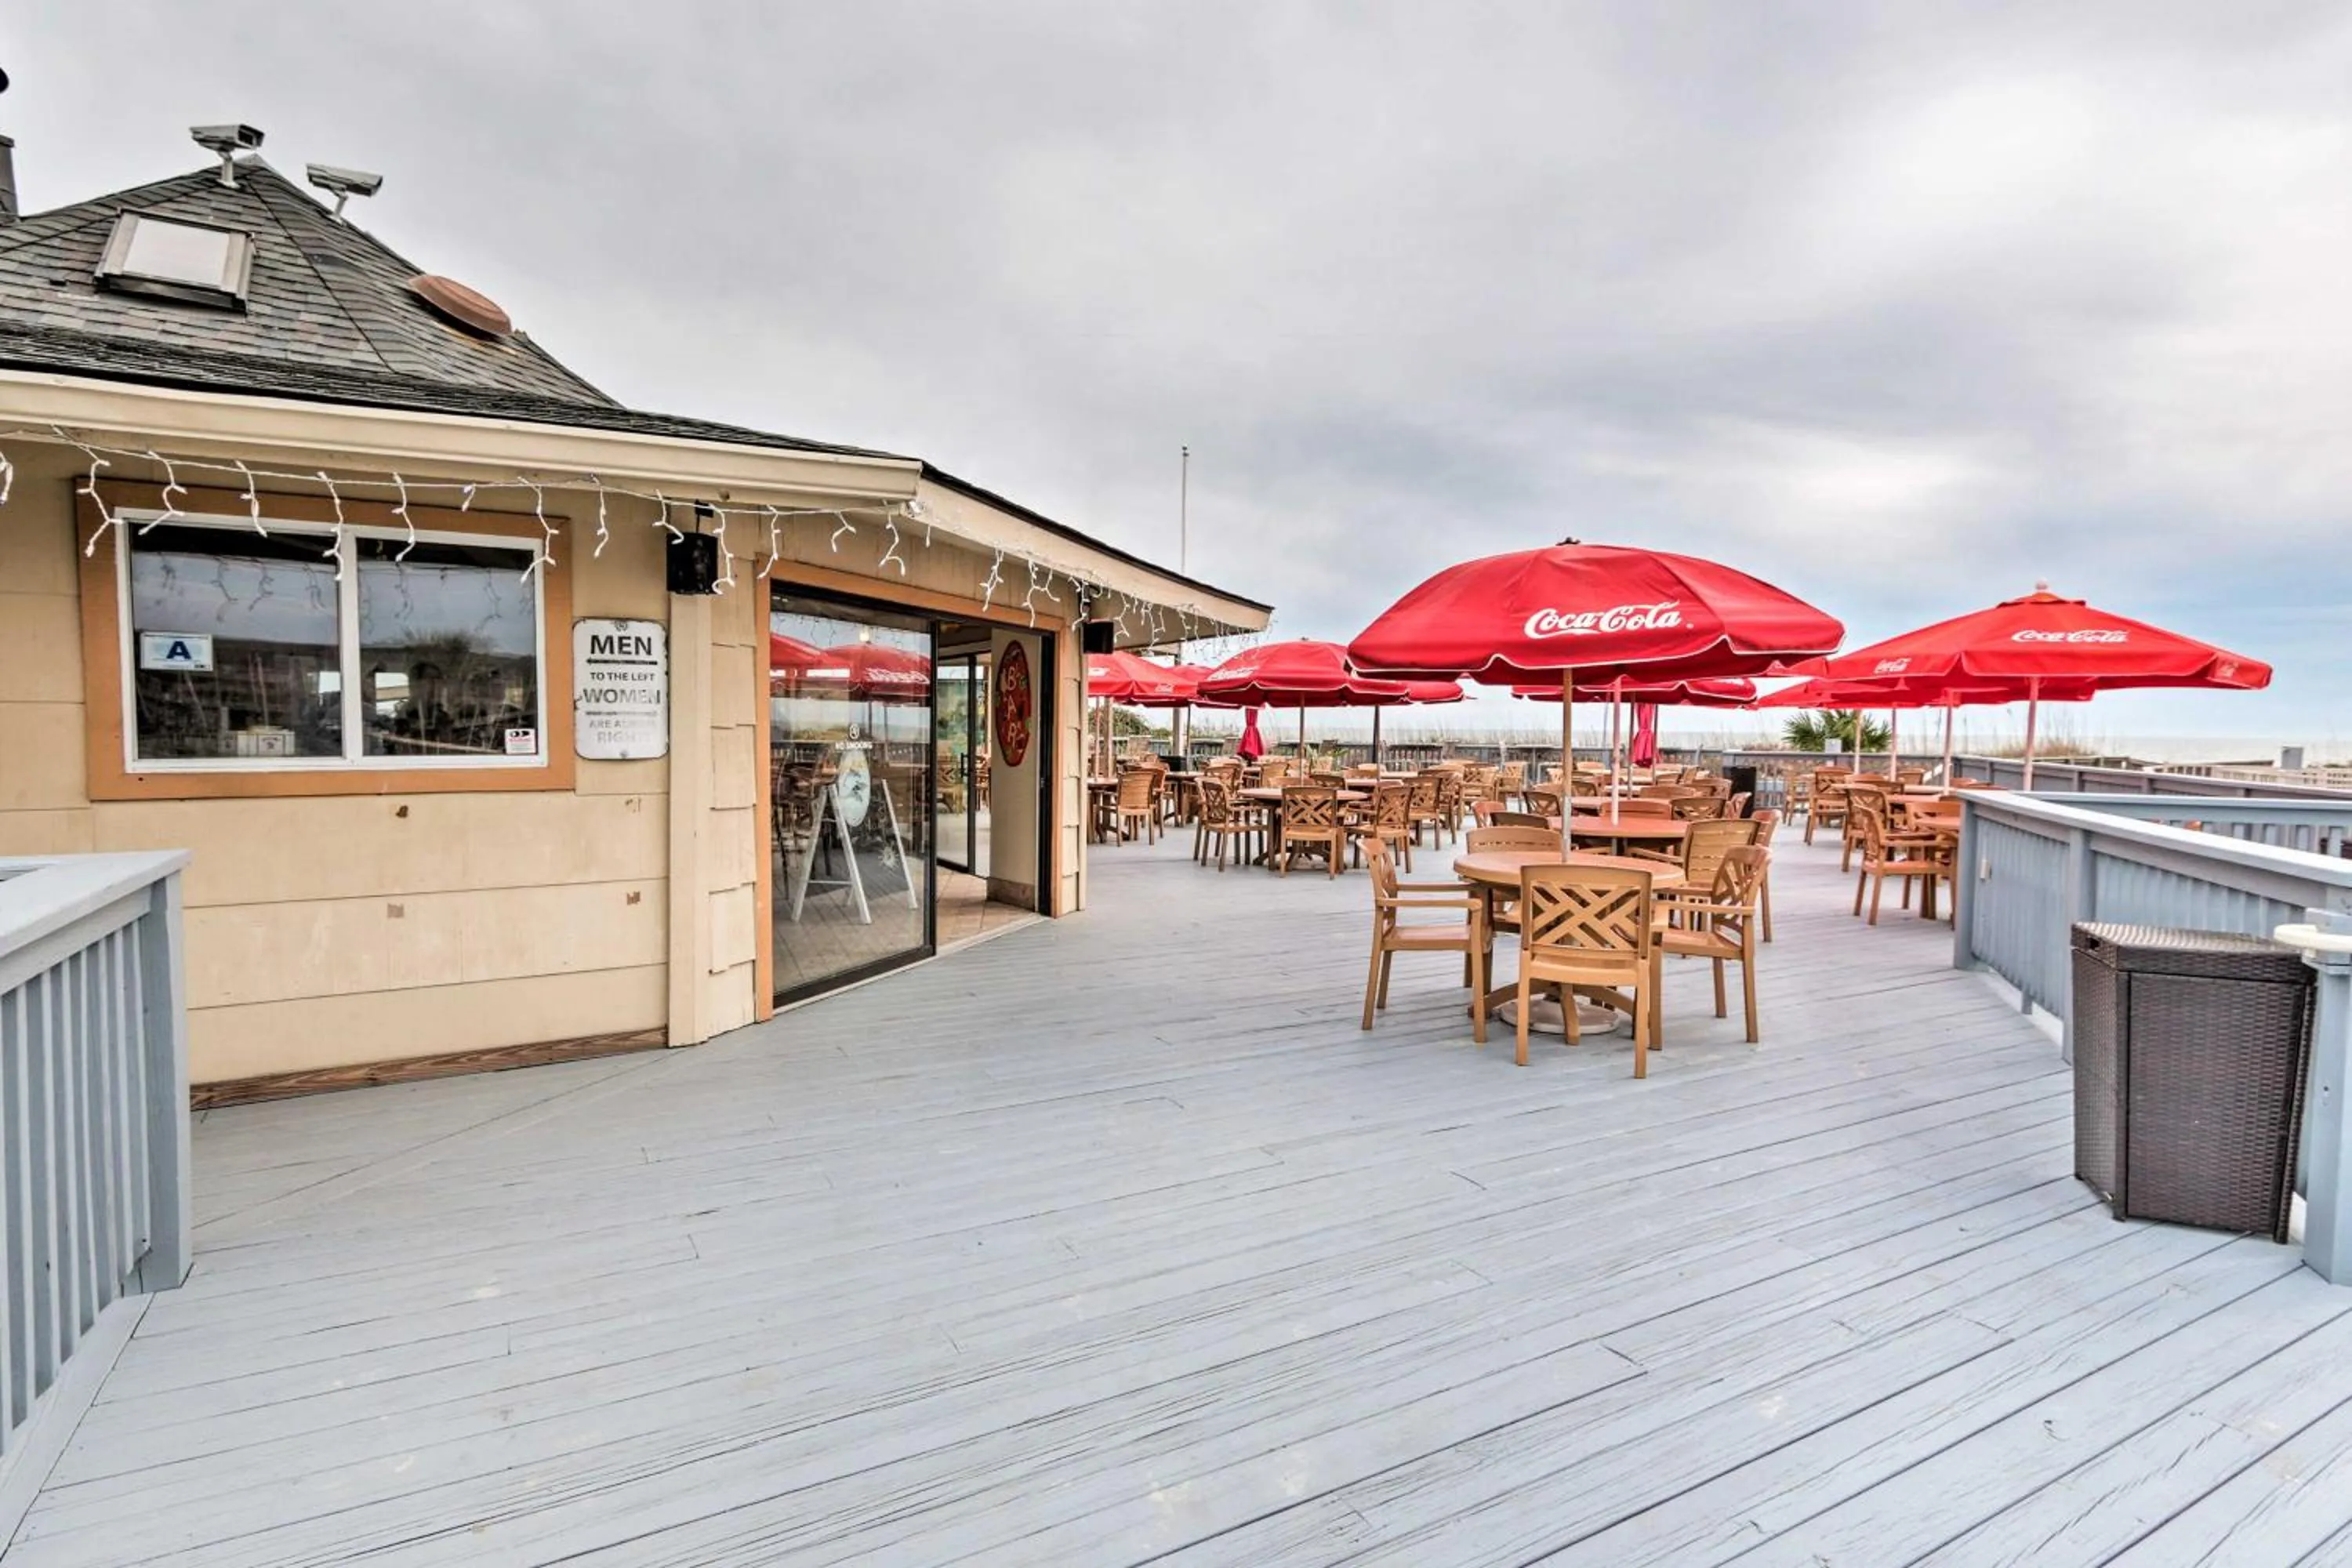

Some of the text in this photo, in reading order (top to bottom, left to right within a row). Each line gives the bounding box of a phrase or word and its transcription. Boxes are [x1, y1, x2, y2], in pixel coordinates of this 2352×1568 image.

[1524, 599, 1682, 639] Coca-Cola
[166, 641, 192, 659] A
[590, 634, 652, 655] MEN
[590, 672, 655, 681] TO THE LEFT
[583, 688, 661, 704] WOMEN
